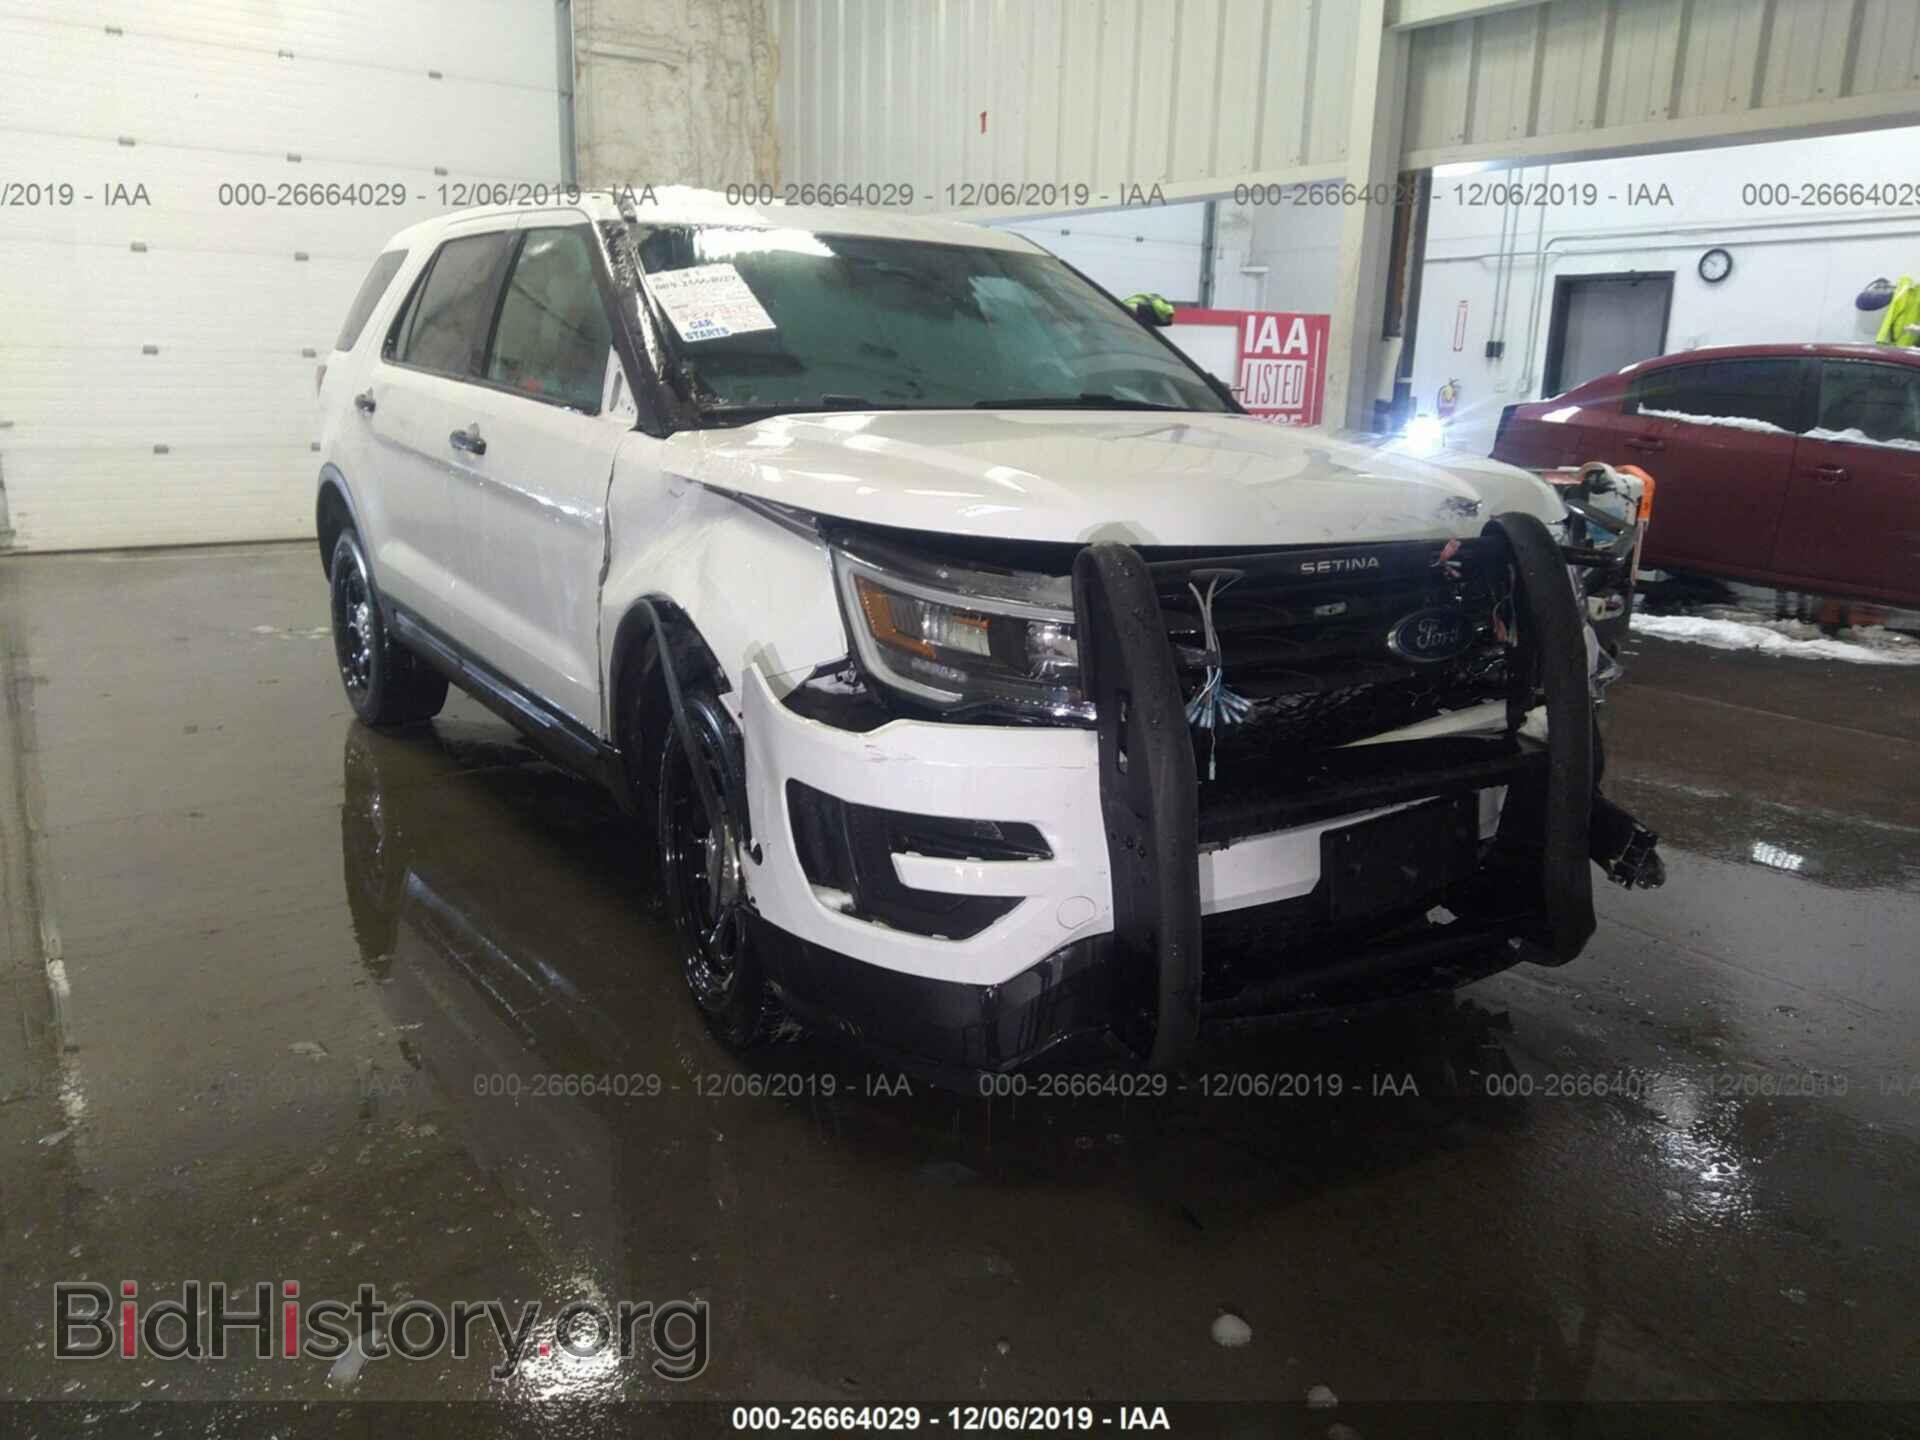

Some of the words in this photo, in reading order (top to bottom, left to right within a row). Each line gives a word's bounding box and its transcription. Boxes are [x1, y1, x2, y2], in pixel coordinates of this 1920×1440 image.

[1243, 314, 1309, 355] IAA
[1243, 363, 1303, 405] LISTED
[1301, 556, 1380, 575] SETINA
[1416, 618, 1459, 649] Ford
